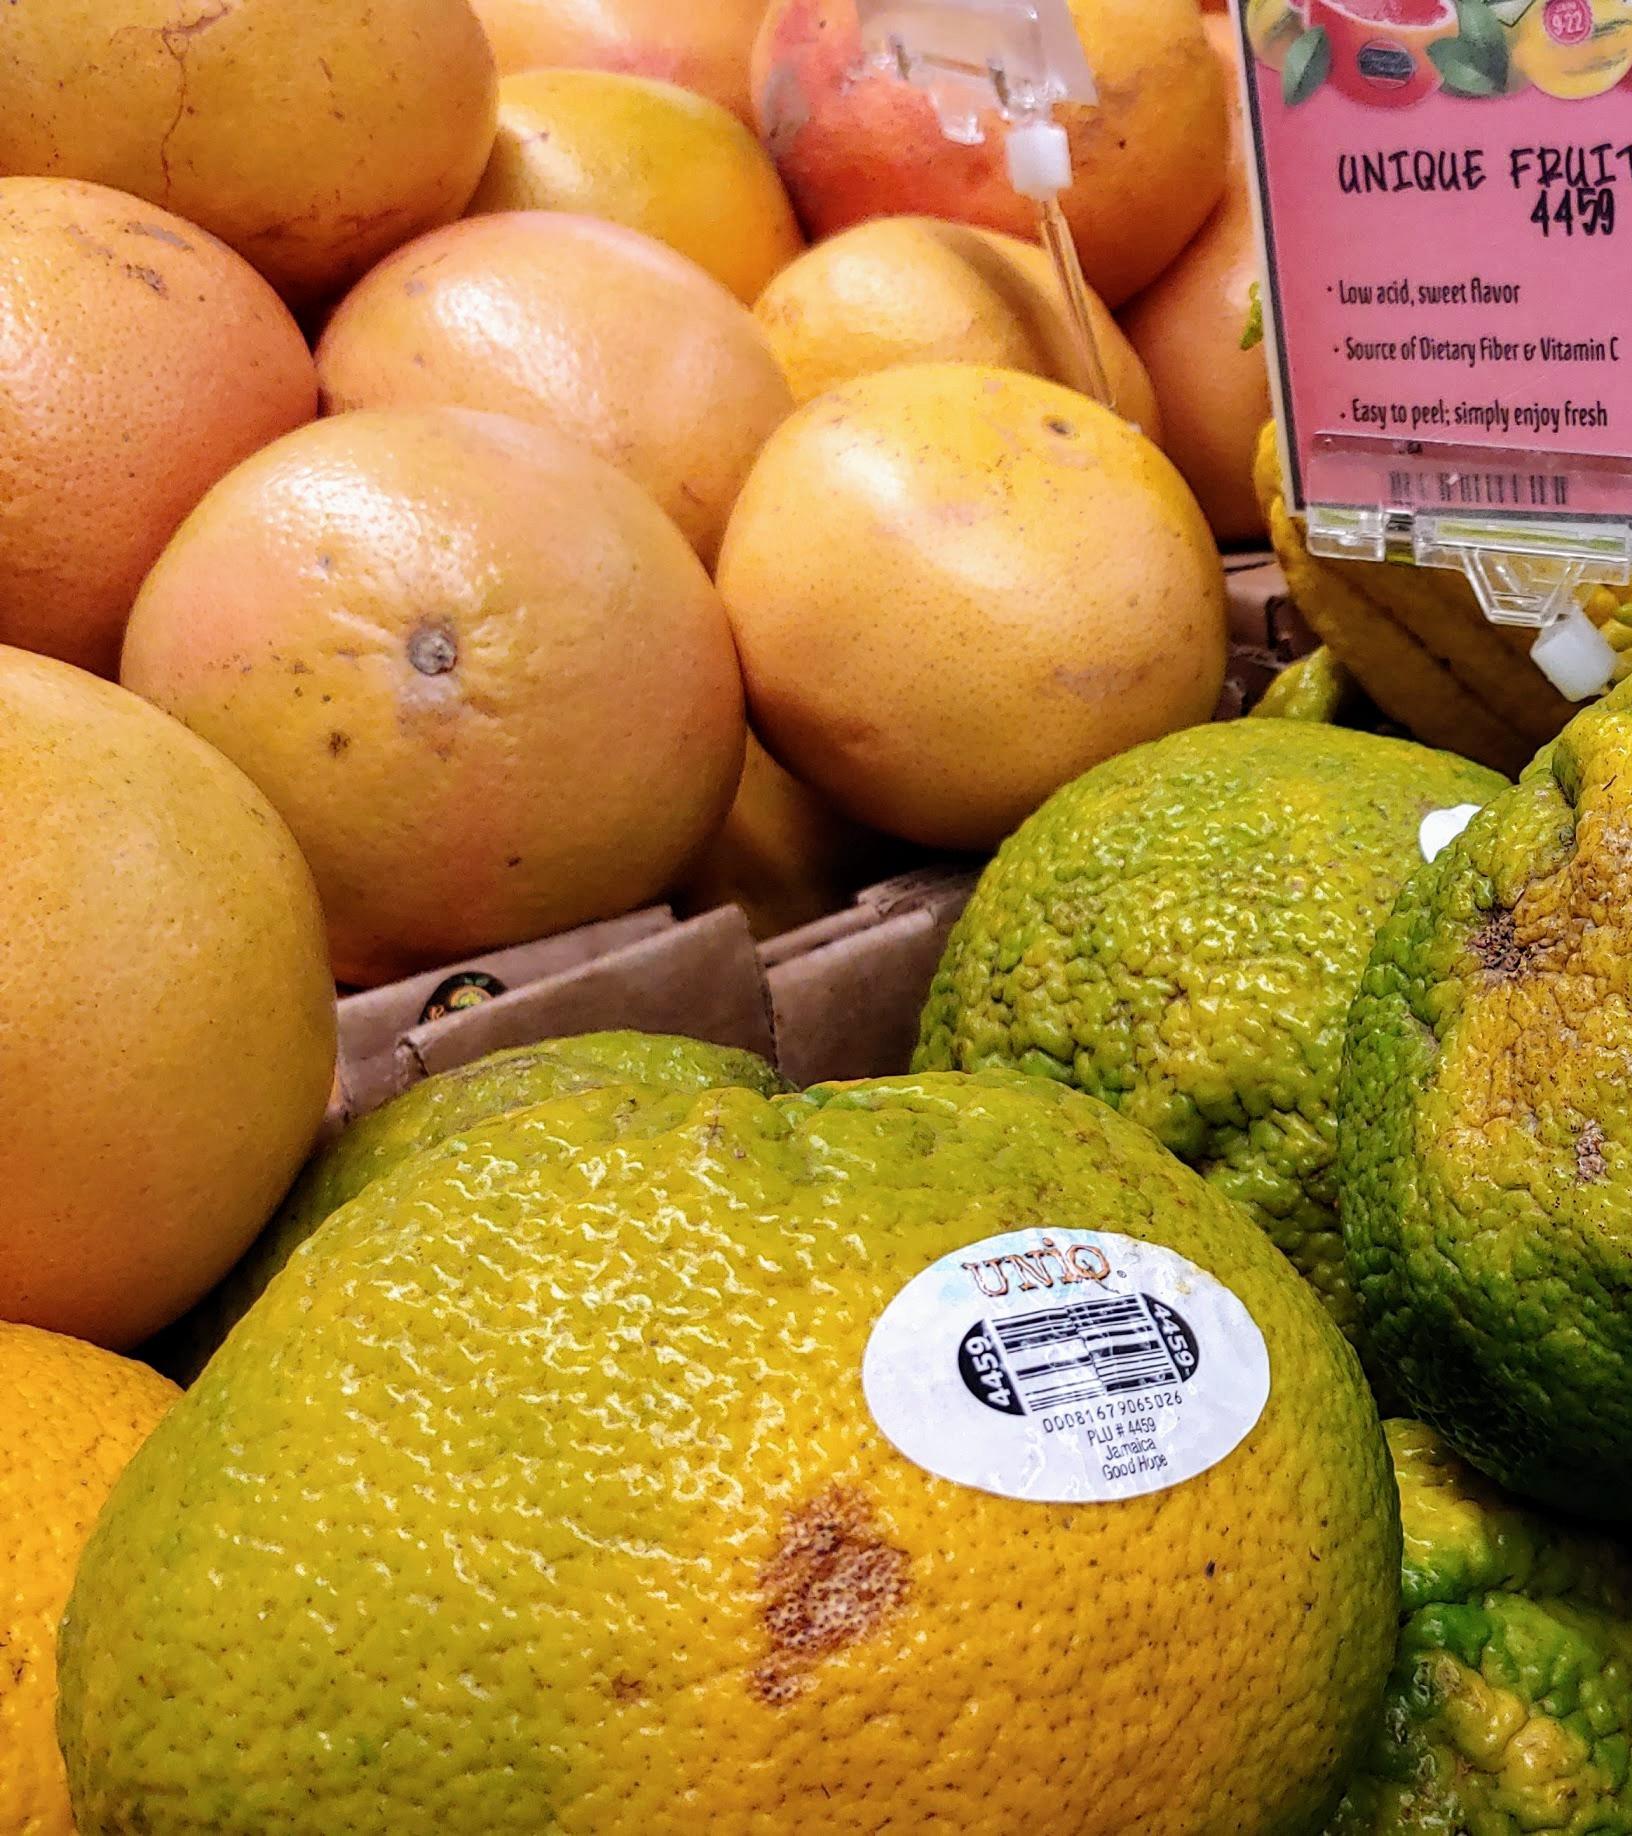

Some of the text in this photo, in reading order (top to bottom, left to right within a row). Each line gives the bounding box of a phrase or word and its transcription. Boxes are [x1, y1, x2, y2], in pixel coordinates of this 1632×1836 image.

[1337, 149, 1486, 194] UNIQUE
[1530, 188, 1616, 237] 4459
[1339, 277, 1521, 307] Low acid, sweet flavor
[1345, 335, 1621, 368] Source of Dietary Fiber & Vitamin C
[1352, 397, 1387, 429] Easy
[1391, 401, 1407, 423] to
[1454, 400, 1509, 432] simply
[1514, 402, 1560, 433] enjoy
[1564, 400, 1609, 427] fresh
[964, 1336, 1011, 1407] 4459
[1087, 1417, 1157, 1446] PLU # 4459
[1105, 1437, 1157, 1461] Jamaica
[1102, 1453, 1168, 1481] Good Hope
